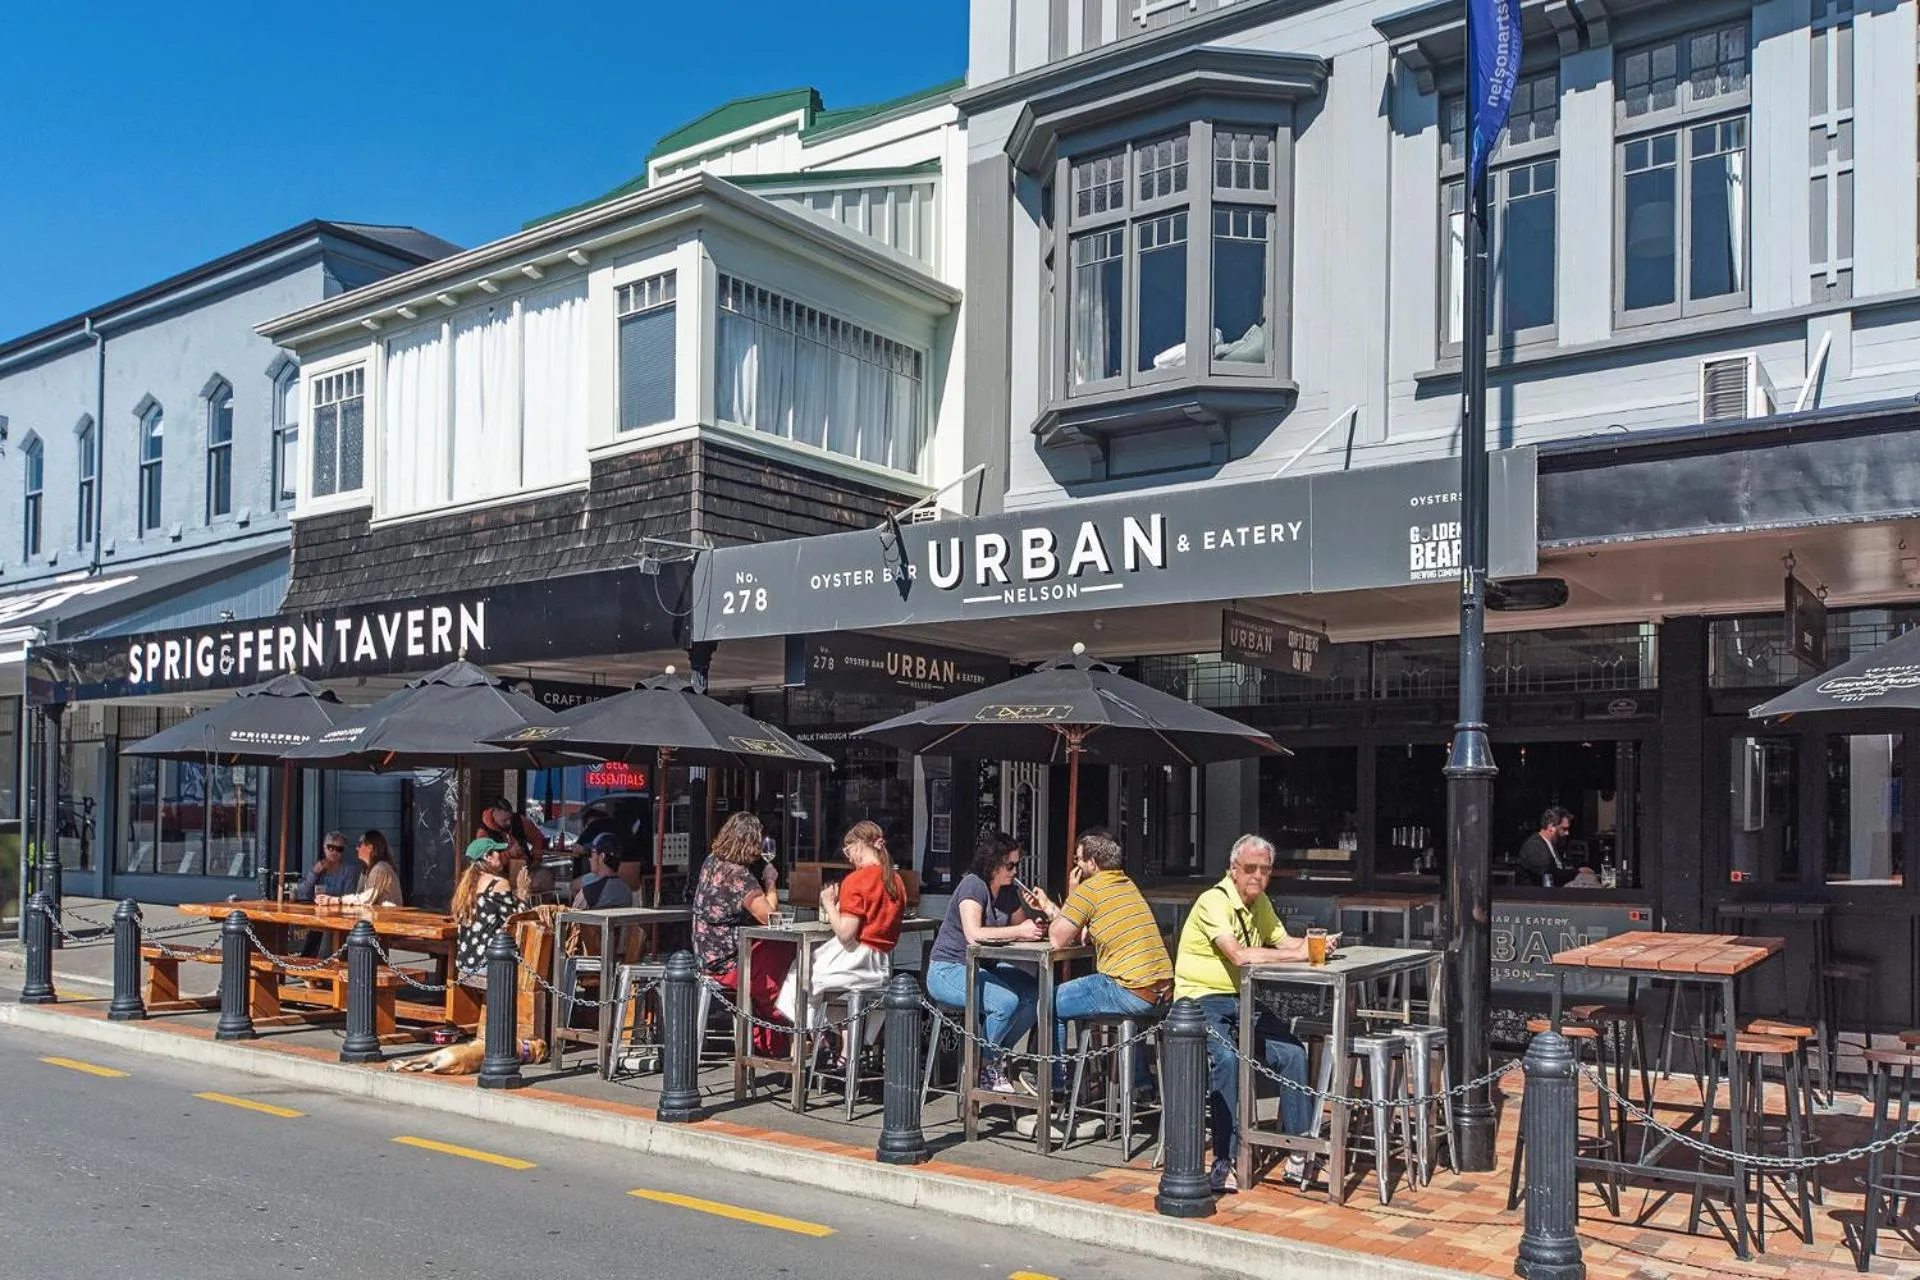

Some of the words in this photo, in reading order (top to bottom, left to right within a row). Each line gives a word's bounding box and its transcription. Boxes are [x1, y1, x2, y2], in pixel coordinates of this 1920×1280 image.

[1487, 0, 1510, 107] nelsonarts
[1177, 535, 1191, 552] &
[1203, 521, 1303, 550] EATERY
[928, 512, 1166, 590] URBAN
[1410, 539, 1462, 570] BEAR
[736, 571, 758, 584] No.
[811, 570, 874, 589] OYSTER
[722, 588, 768, 614] 278
[1004, 583, 1078, 604] NELSON
[129, 635, 215, 684] SPRIG
[238, 622, 323, 674] FERN
[335, 601, 485, 663] TAVERN
[1231, 627, 1272, 654] URBAN
[813, 655, 835, 671] 278
[844, 656, 870, 668] OYSTER
[887, 651, 954, 683] URBAN
[962, 673, 985, 684] EATERY
[543, 692, 582, 706] CRAFT
[589, 772, 645, 786] ESSENTIALS
[1491, 916, 1510, 924] AR
[1526, 916, 1569, 926] EATERY
[1491, 928, 1589, 965] BAN
